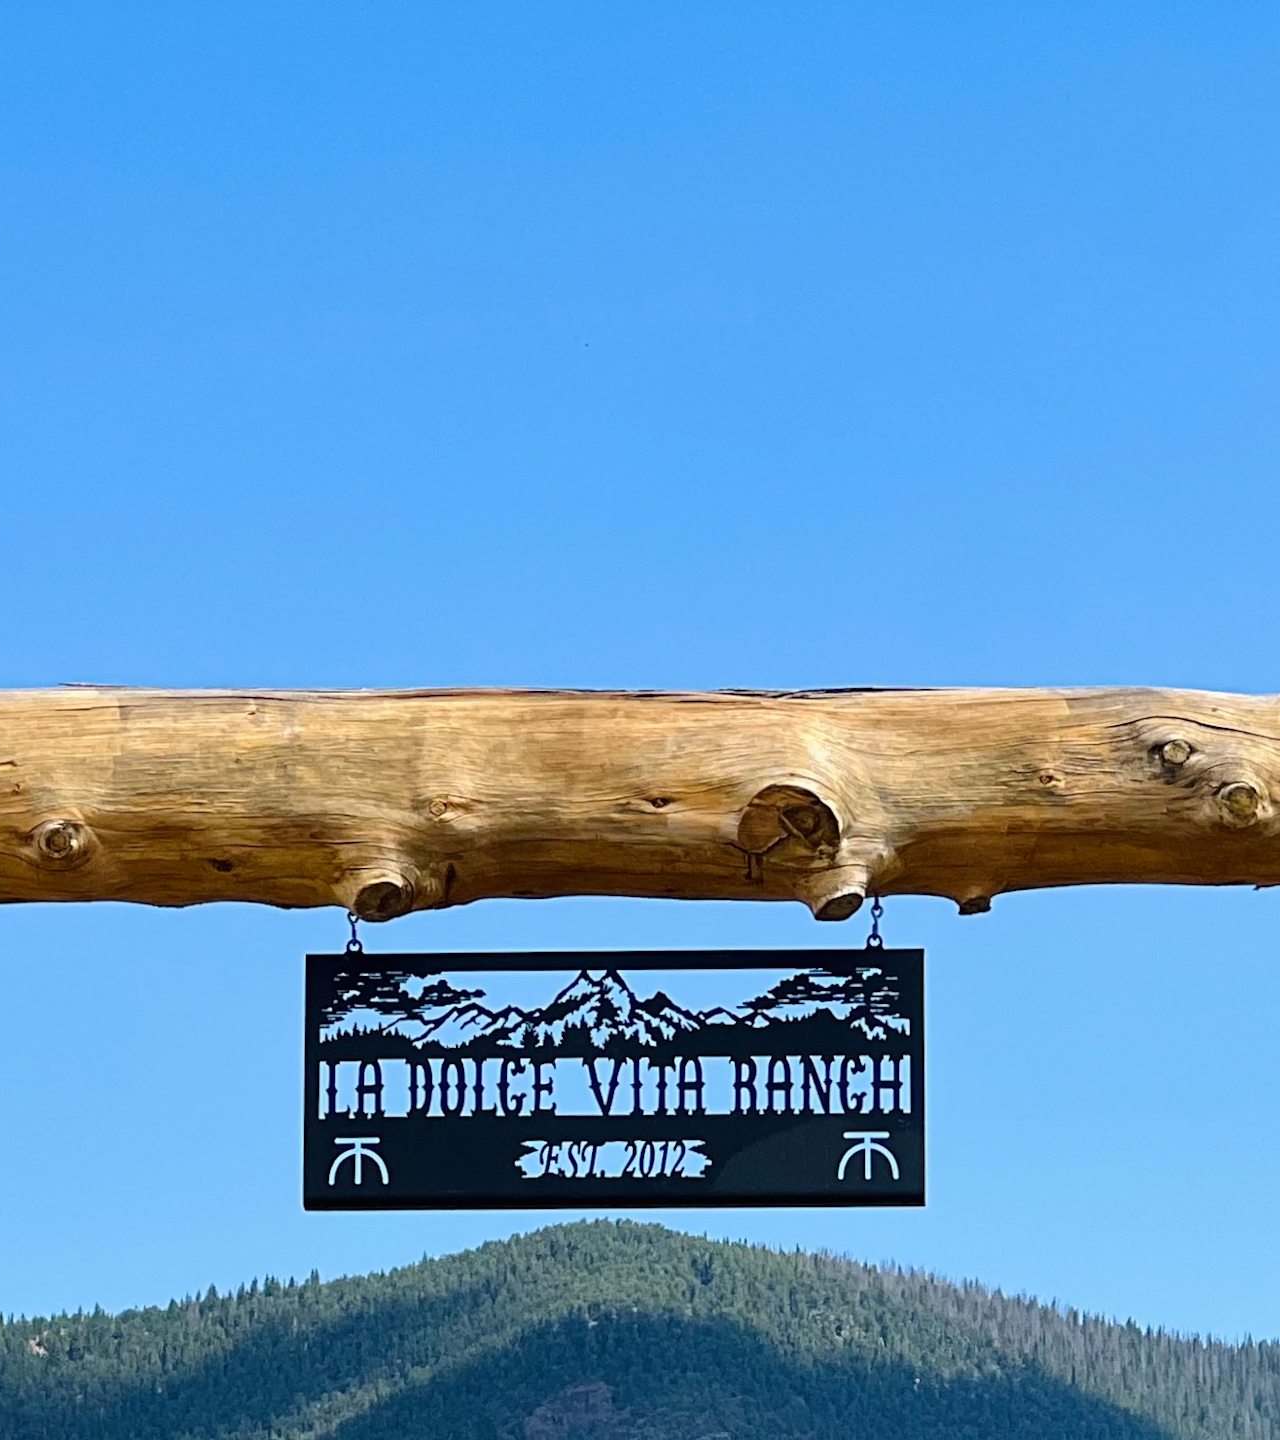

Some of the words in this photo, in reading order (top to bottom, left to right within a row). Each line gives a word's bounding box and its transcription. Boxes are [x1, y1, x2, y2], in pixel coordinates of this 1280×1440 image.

[326, 1060, 384, 1119] LA
[408, 1058, 556, 1117] DOLCE
[584, 1056, 706, 1115] VITA
[731, 1055, 905, 1114] RANCH
[623, 1140, 688, 1178] 2012
